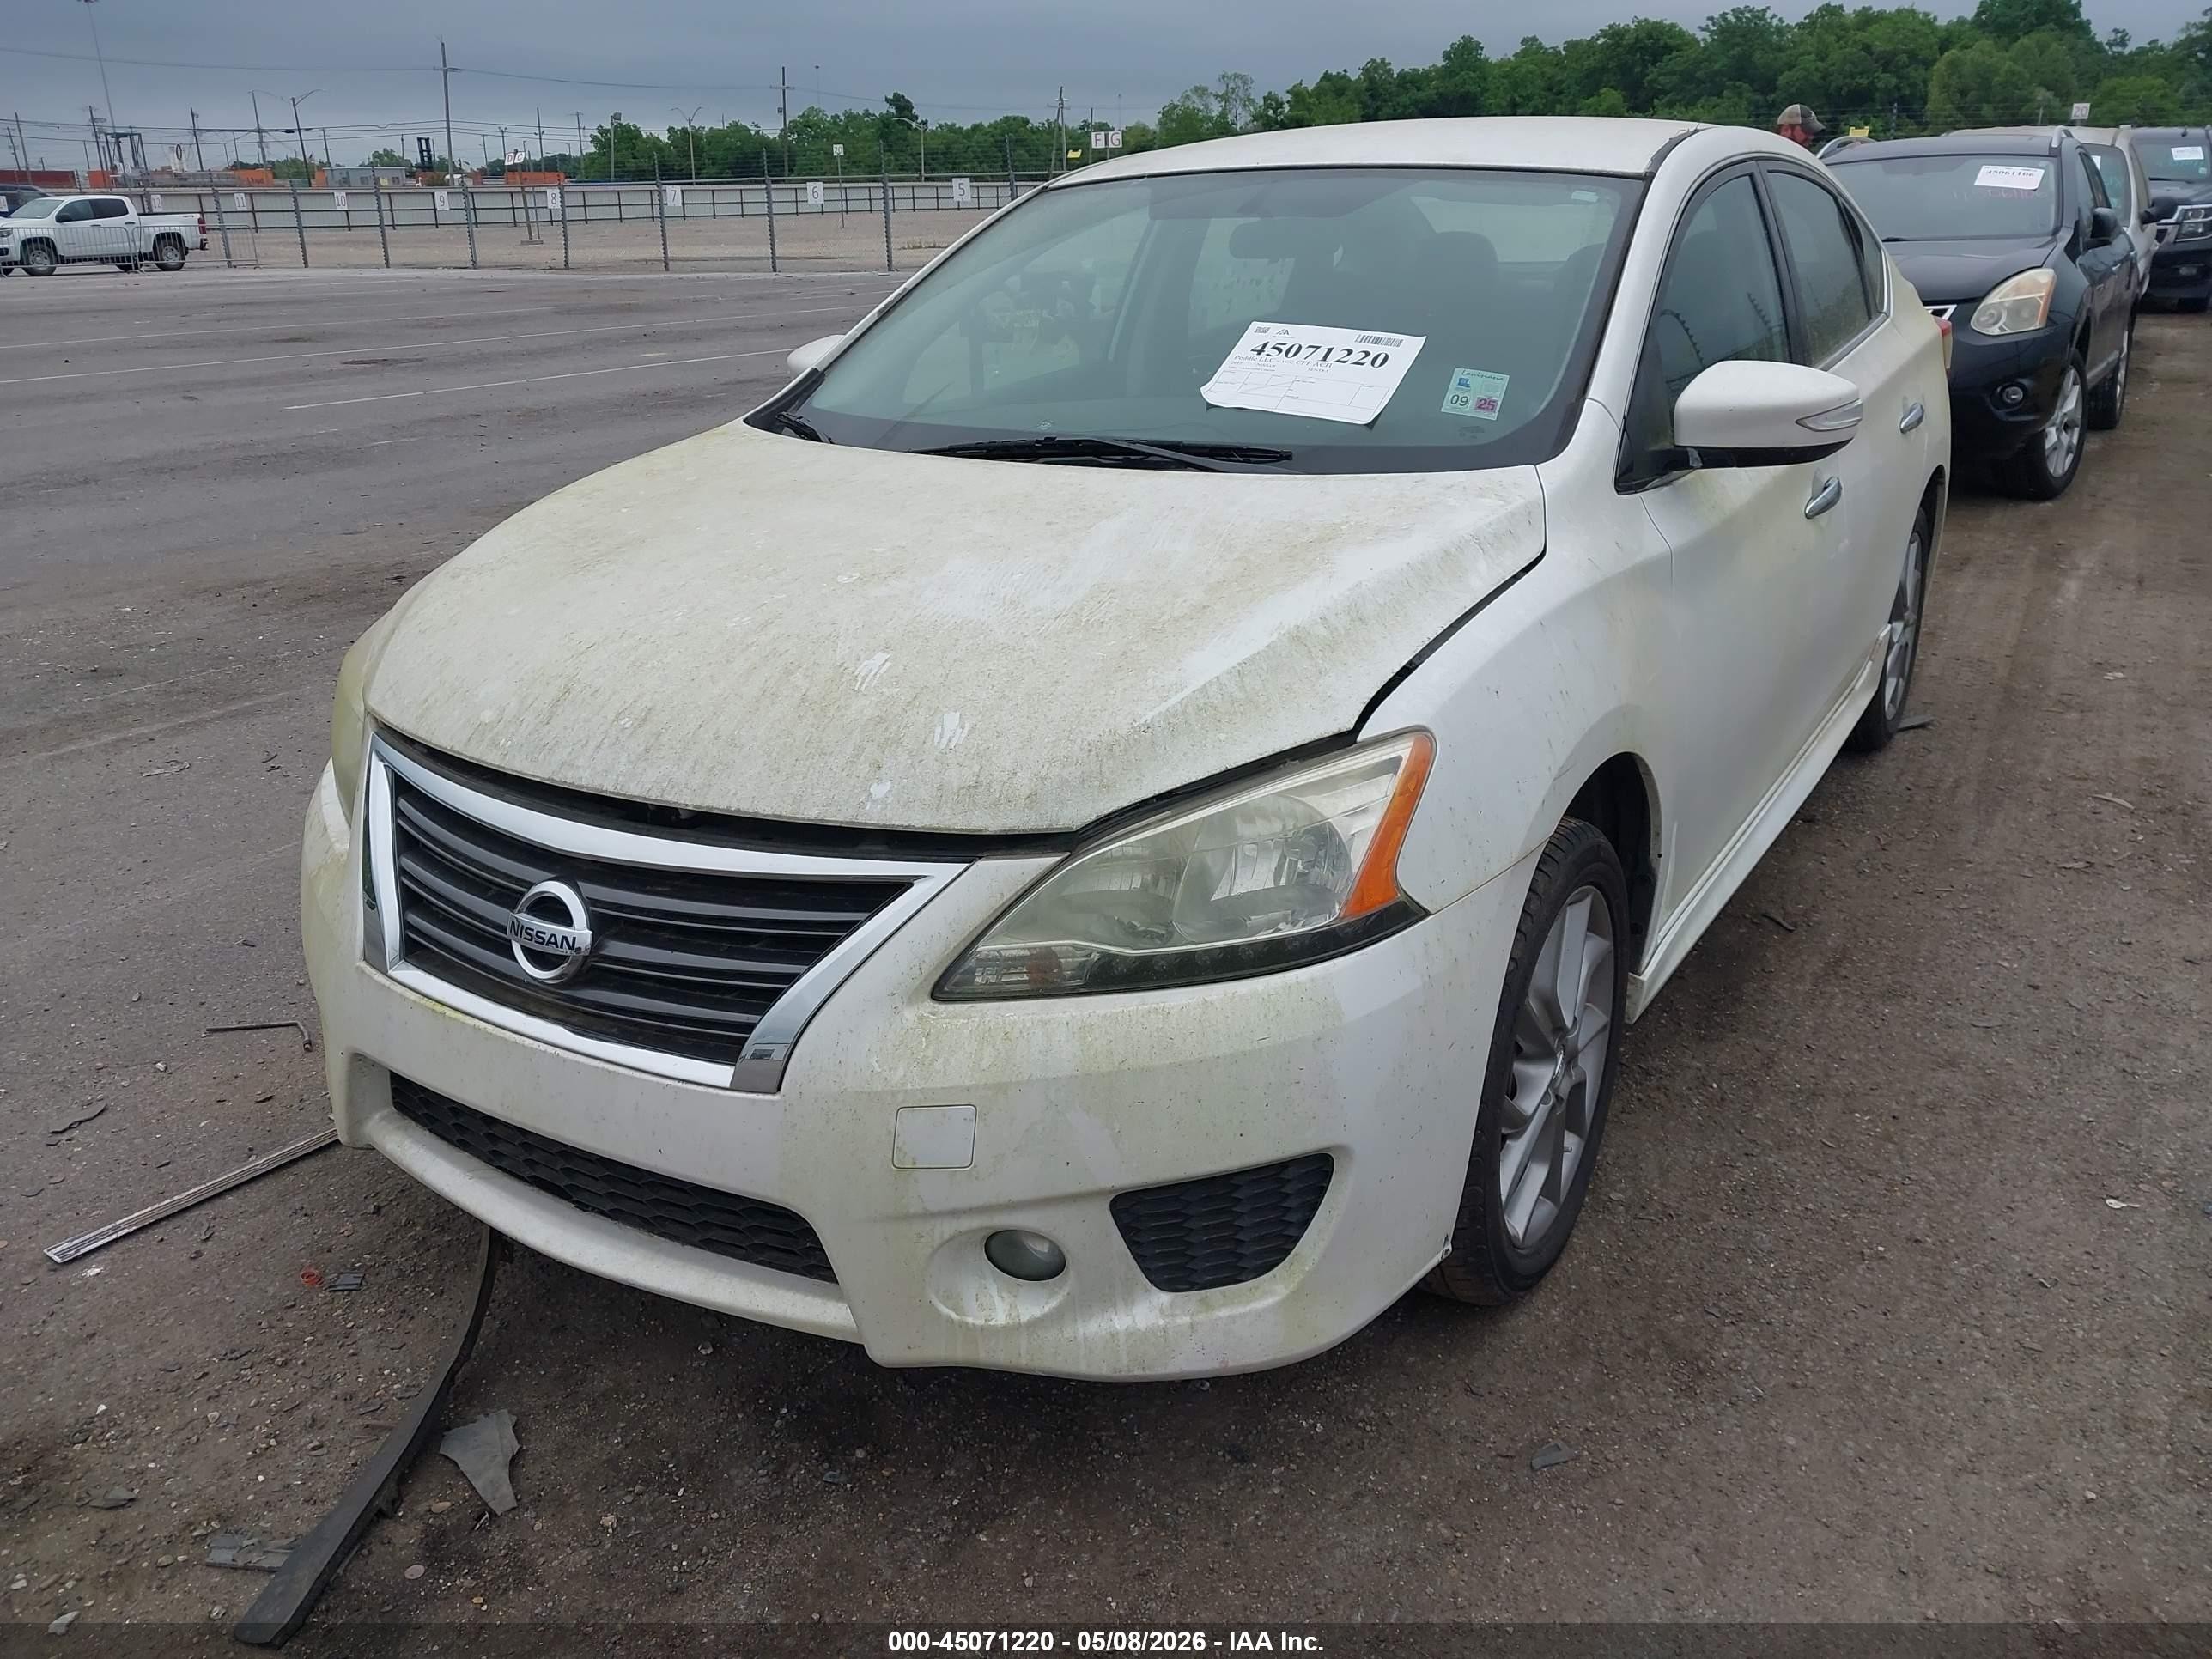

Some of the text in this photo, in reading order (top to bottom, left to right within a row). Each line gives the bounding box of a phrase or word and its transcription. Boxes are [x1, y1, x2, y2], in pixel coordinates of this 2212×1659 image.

[2074, 106, 2088, 118] 20
[1094, 131, 1121, 147] F G
[833, 146, 843, 155] 20
[671, 190, 677, 202] 7
[811, 185, 819, 199] 6
[958, 182, 966, 197] 5
[236, 197, 246, 208] 11
[336, 195, 346, 207] 10
[439, 195, 445, 206] 9
[550, 192, 556, 205] 8
[1250, 341, 1389, 368] 45071220
[1450, 394, 1496, 411] 09 25
[509, 920, 576, 951] NISSAN
